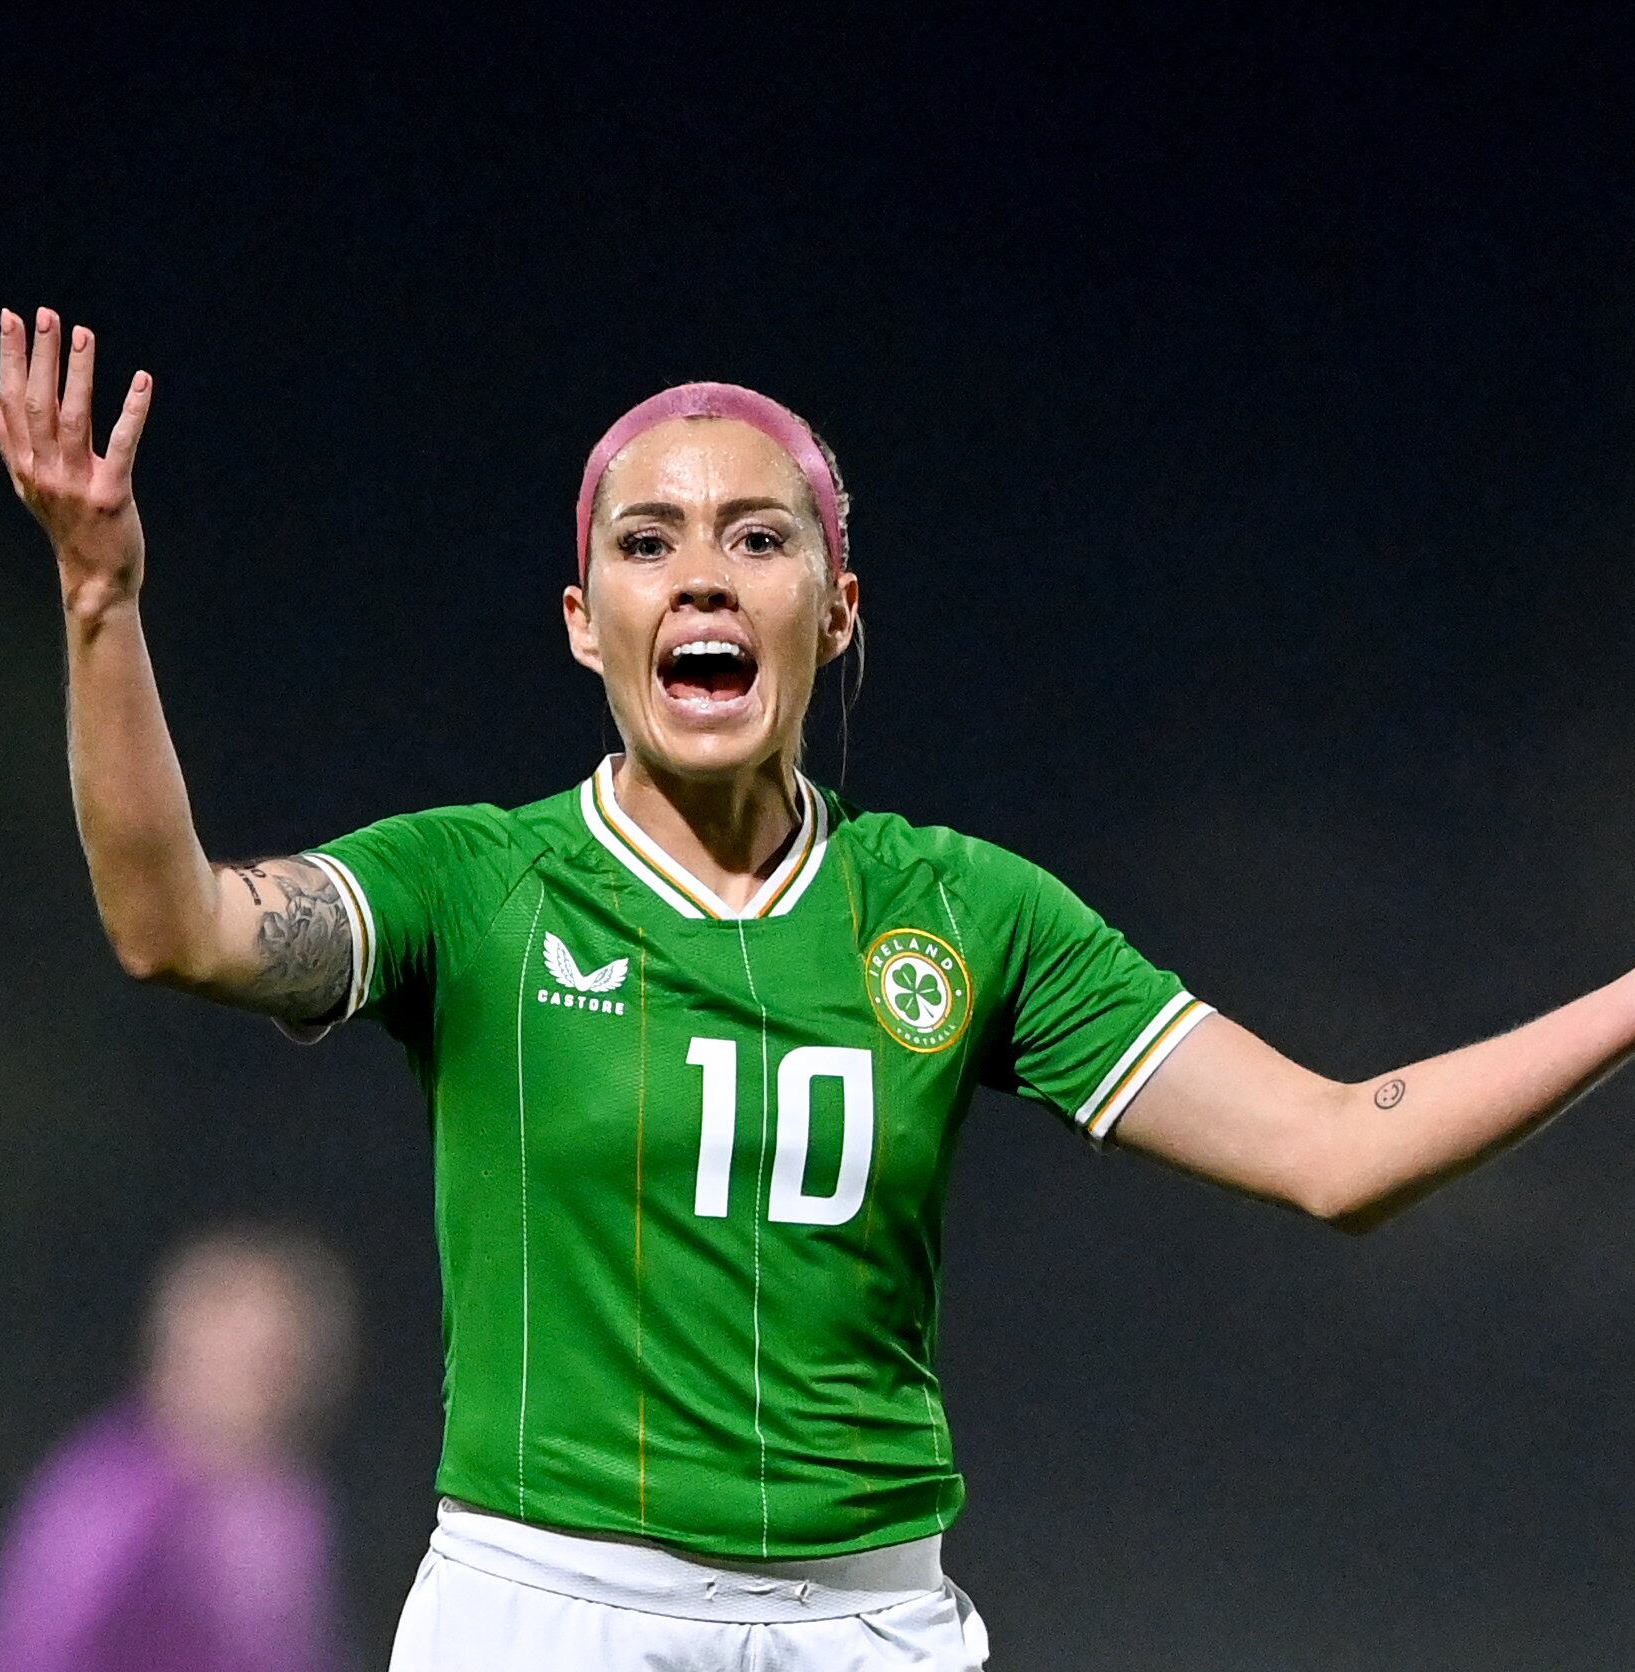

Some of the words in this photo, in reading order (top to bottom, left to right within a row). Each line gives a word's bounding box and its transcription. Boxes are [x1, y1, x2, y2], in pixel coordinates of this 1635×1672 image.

[869, 937, 954, 977] IRELAND
[537, 989, 625, 1016] CASTORE
[685, 1036, 874, 1226] 10
